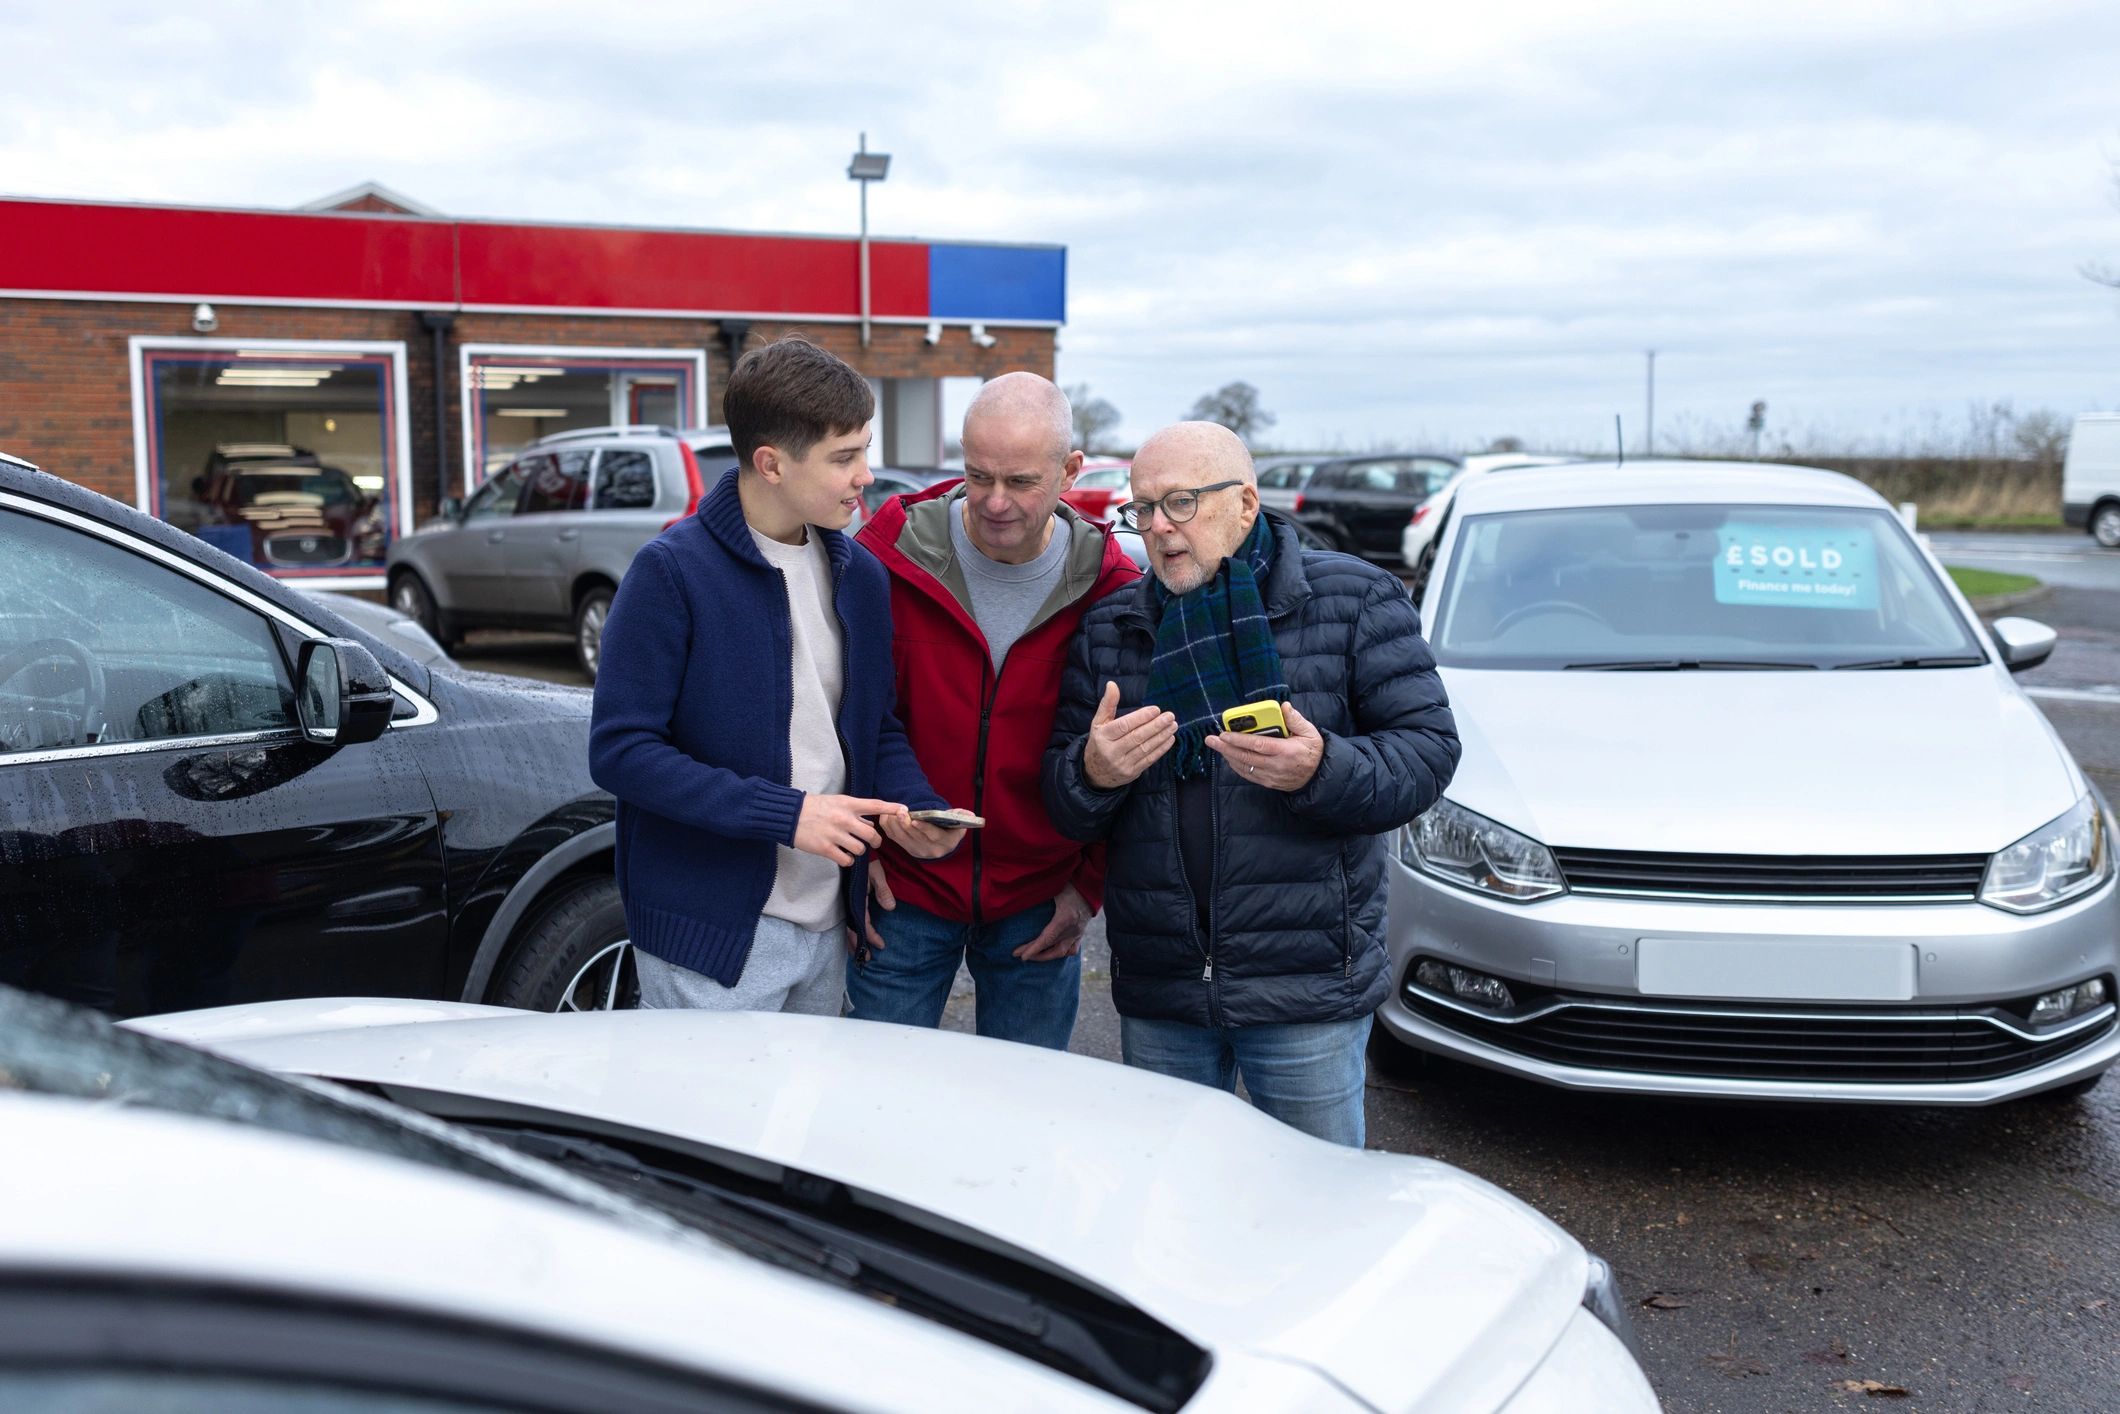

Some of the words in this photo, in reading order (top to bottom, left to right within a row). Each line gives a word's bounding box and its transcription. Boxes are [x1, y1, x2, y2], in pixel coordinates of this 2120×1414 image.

[1738, 579, 1789, 593] Finance
[1792, 584, 1811, 593] me
[1814, 583, 1857, 597] today!
